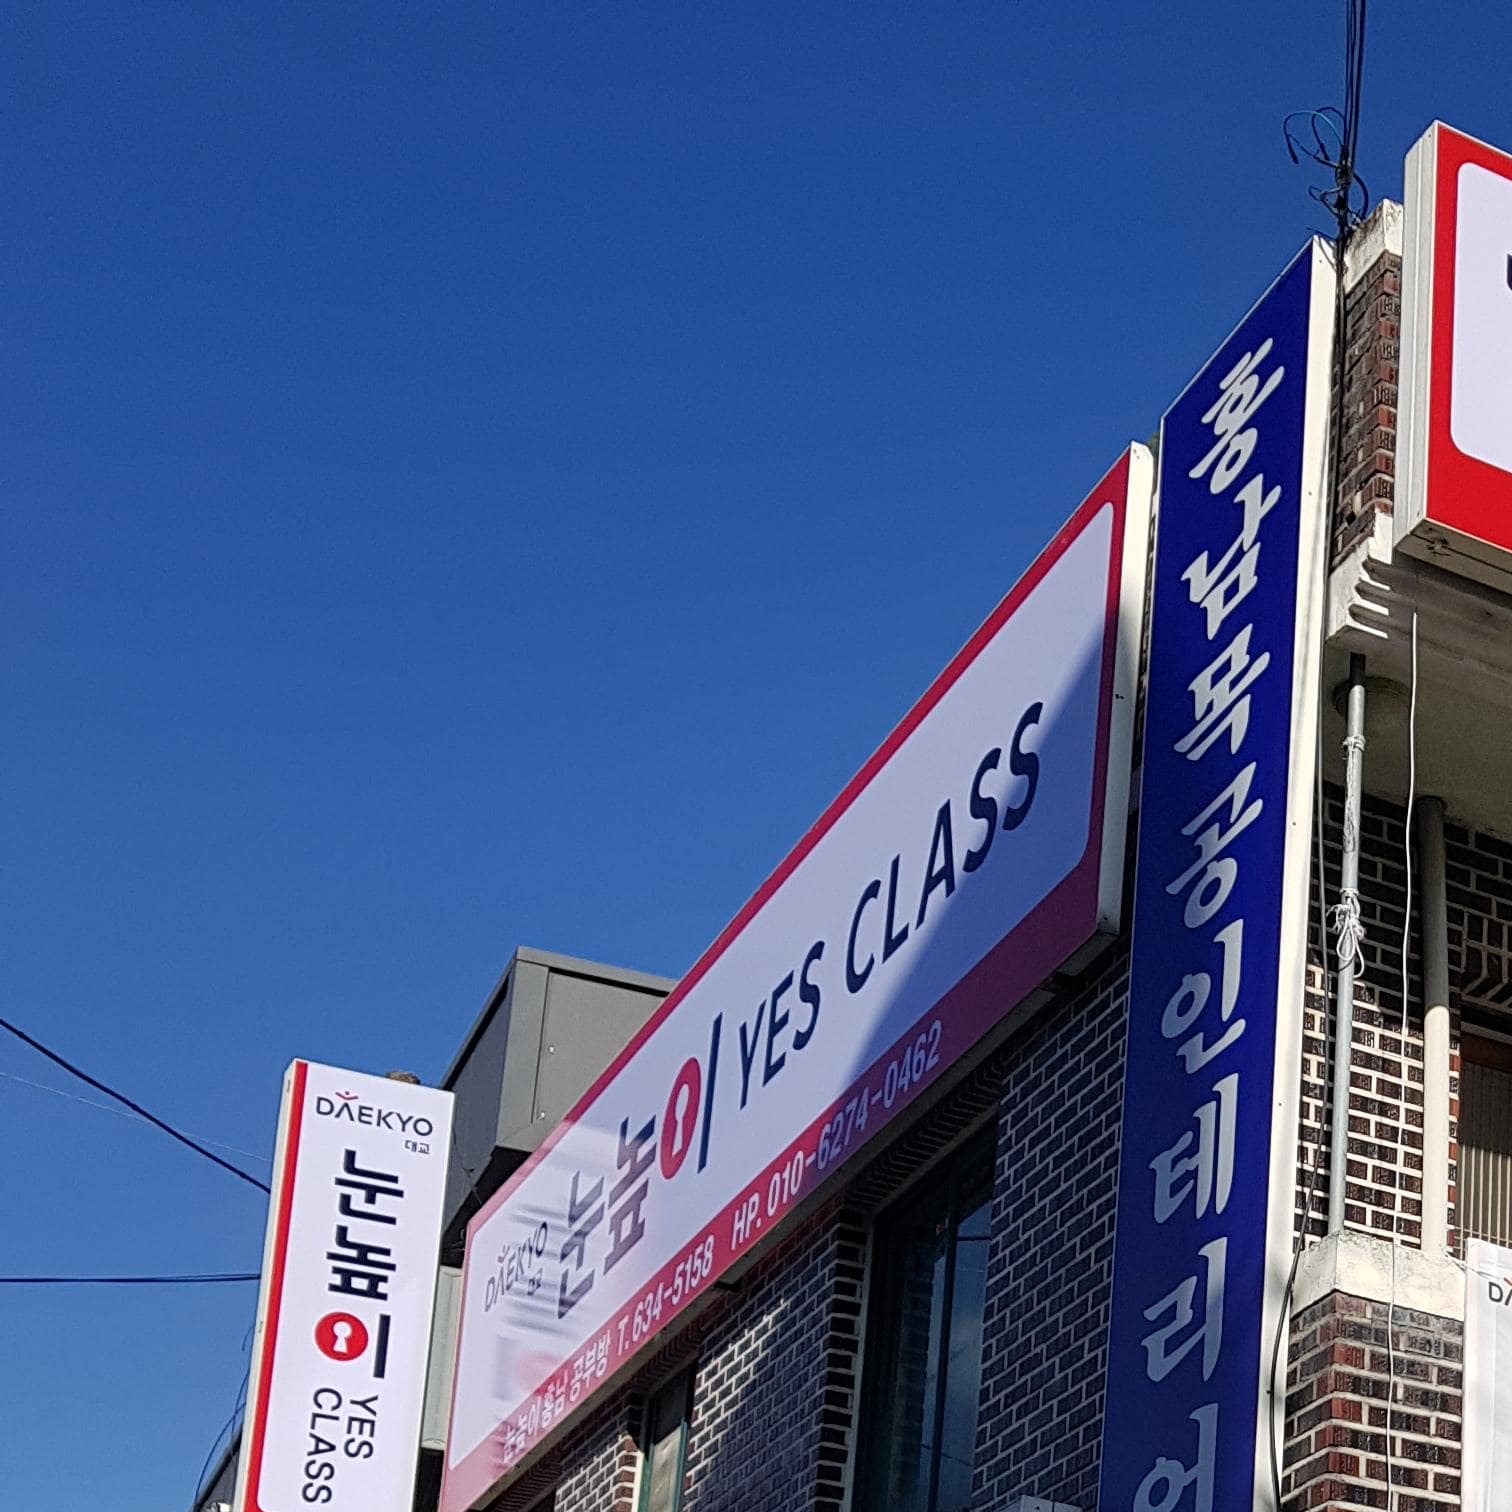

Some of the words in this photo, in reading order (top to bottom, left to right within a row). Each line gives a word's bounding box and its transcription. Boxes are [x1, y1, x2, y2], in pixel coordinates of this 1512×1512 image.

[557, 1010, 724, 1319] 눈높이
[738, 940, 826, 1110] YES
[845, 701, 1045, 994] CLASS
[316, 1093, 433, 1138] DAEKYO
[404, 1139, 430, 1156] 대교
[314, 1149, 404, 1379] 눈높이
[568, 1330, 611, 1403] 공부방
[302, 1386, 343, 1505] CLASS
[344, 1395, 379, 1461] YES
